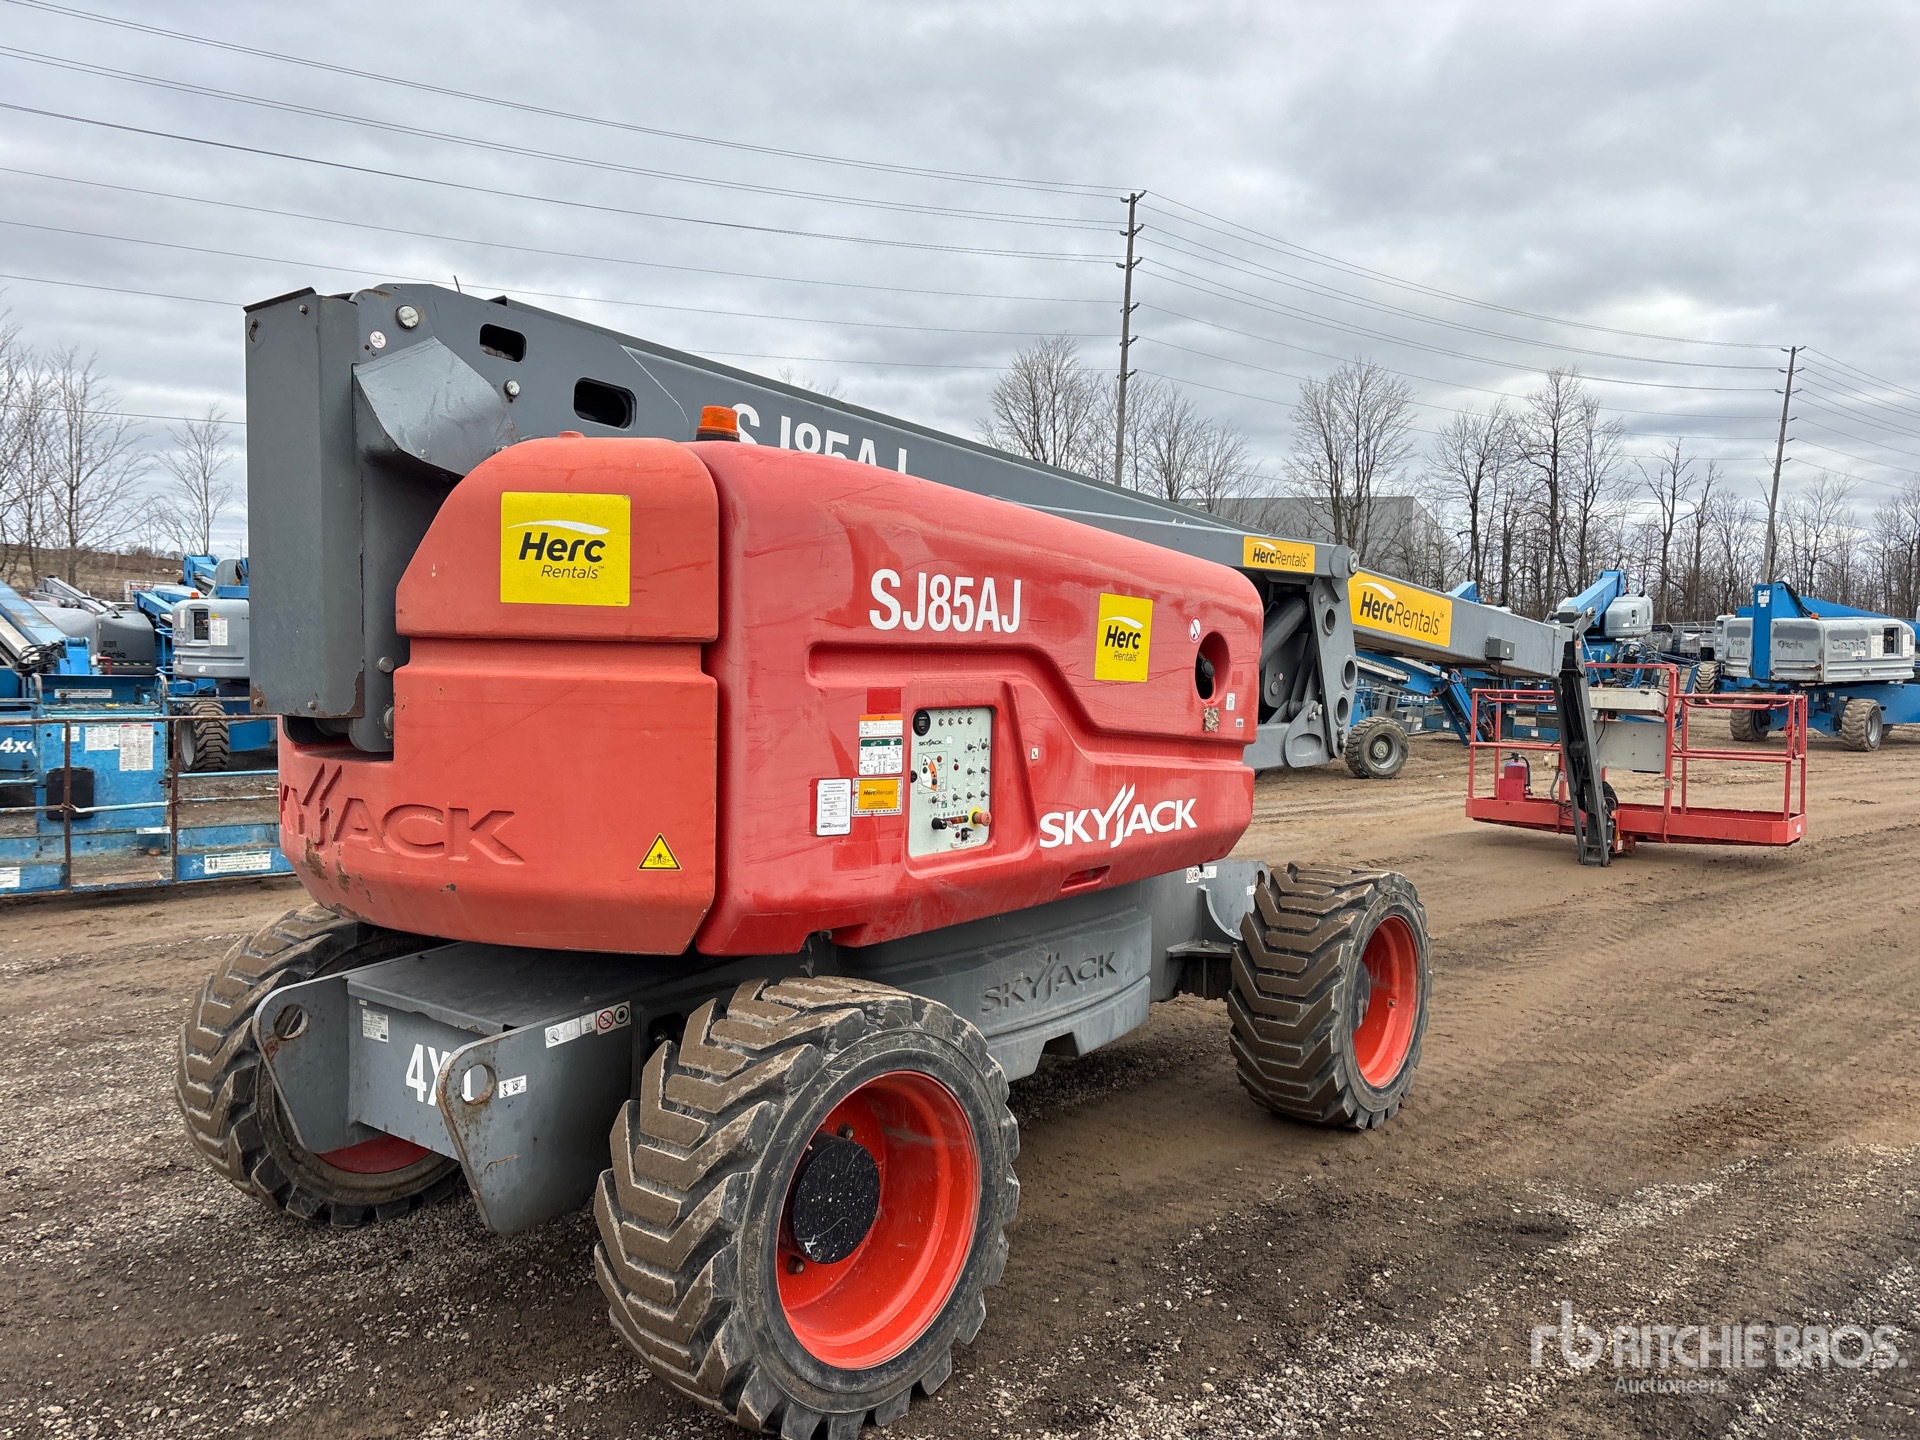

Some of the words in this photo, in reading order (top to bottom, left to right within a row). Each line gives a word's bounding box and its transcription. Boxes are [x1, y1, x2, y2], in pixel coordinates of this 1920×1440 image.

[518, 531, 606, 563] Herc
[869, 568, 1022, 633] SJ85AJ
[1104, 625, 1142, 650] Herc
[1039, 783, 1198, 849] SKYJACK
[980, 951, 1118, 1014] SKYJACK
[405, 1043, 475, 1106] 4X
